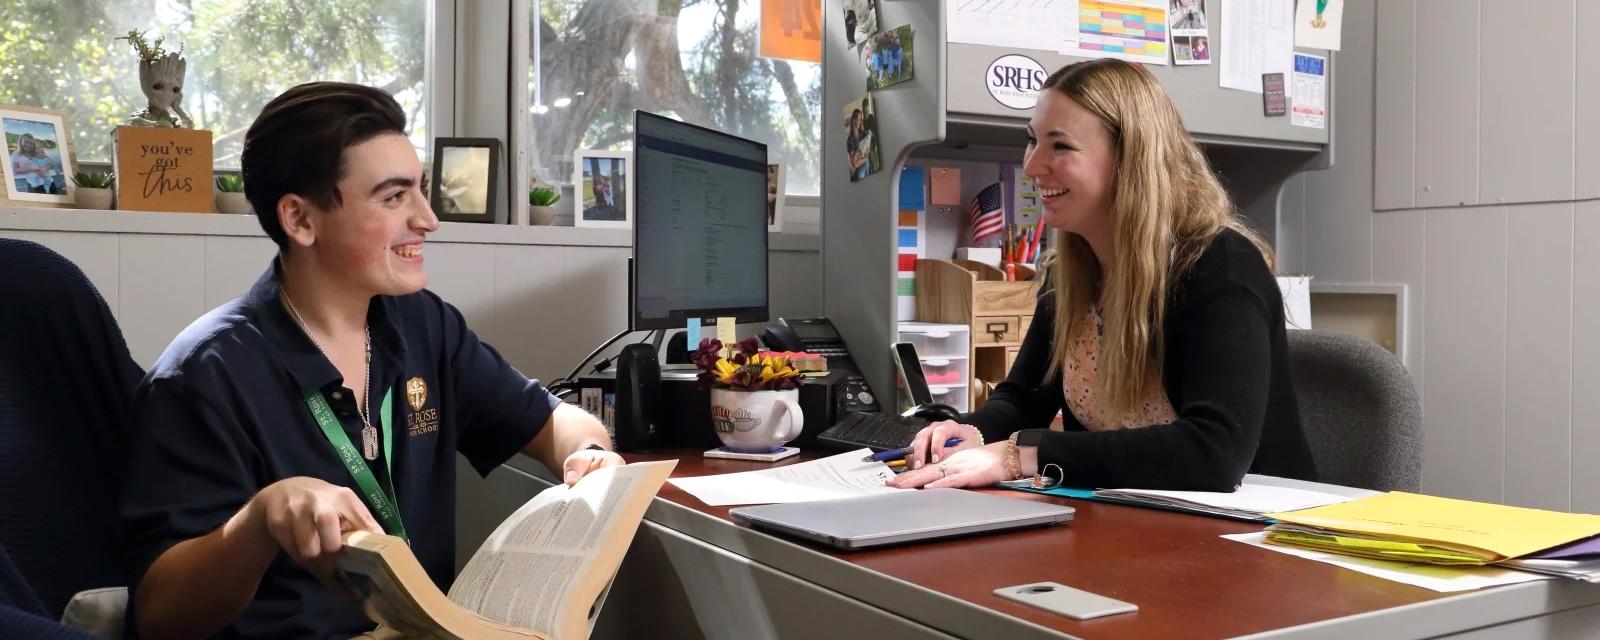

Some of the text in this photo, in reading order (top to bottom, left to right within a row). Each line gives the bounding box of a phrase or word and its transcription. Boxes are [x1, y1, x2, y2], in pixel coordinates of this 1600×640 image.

[992, 65, 1043, 92] SRHS
[141, 141, 193, 158] you've
[155, 157, 178, 171] got
[138, 164, 193, 199] this
[415, 408, 438, 424] ROSE
